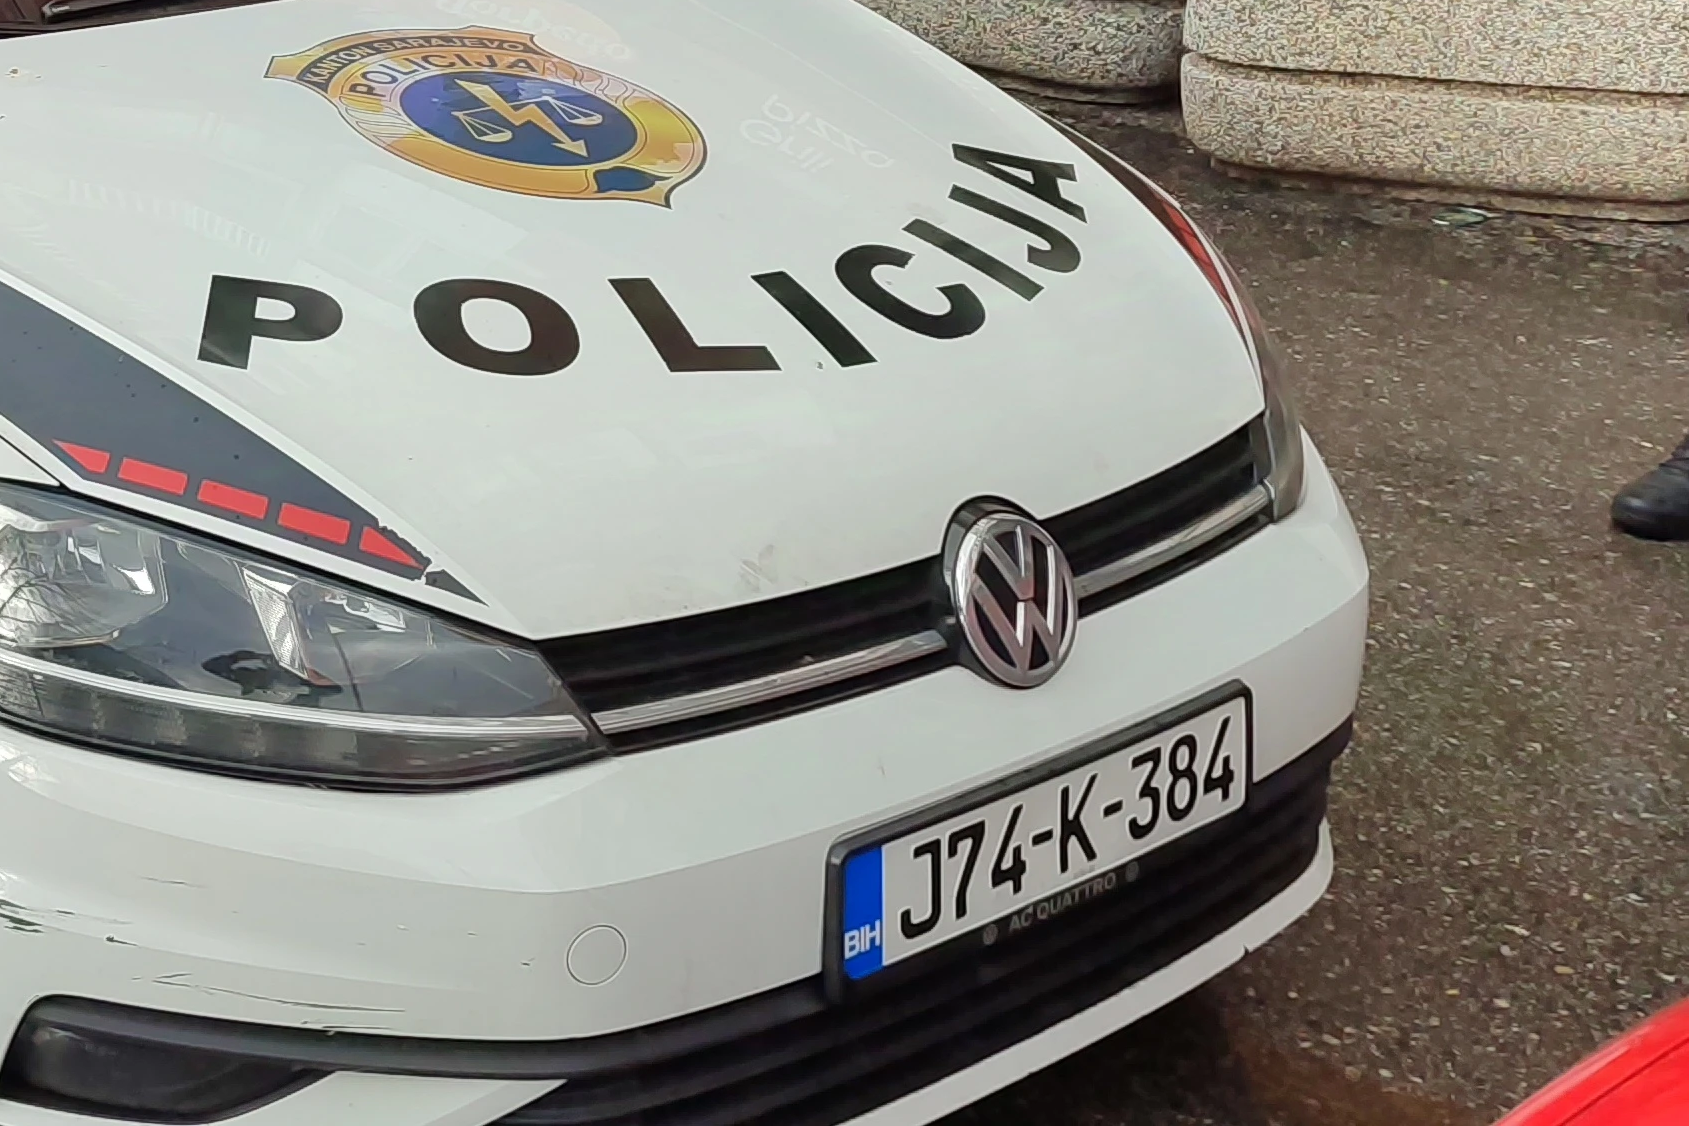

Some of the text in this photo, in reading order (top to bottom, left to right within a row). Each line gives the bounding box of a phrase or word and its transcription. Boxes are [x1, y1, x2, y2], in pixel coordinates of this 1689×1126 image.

[305, 35, 525, 84] KANTON SARAJEVO
[348, 53, 540, 99] POLICIJA
[197, 143, 1088, 376] POLICIJA
[898, 715, 1235, 941] J74-K-384
[1009, 873, 1117, 932] AC QUATTRO
[844, 919, 882, 960] BIH
